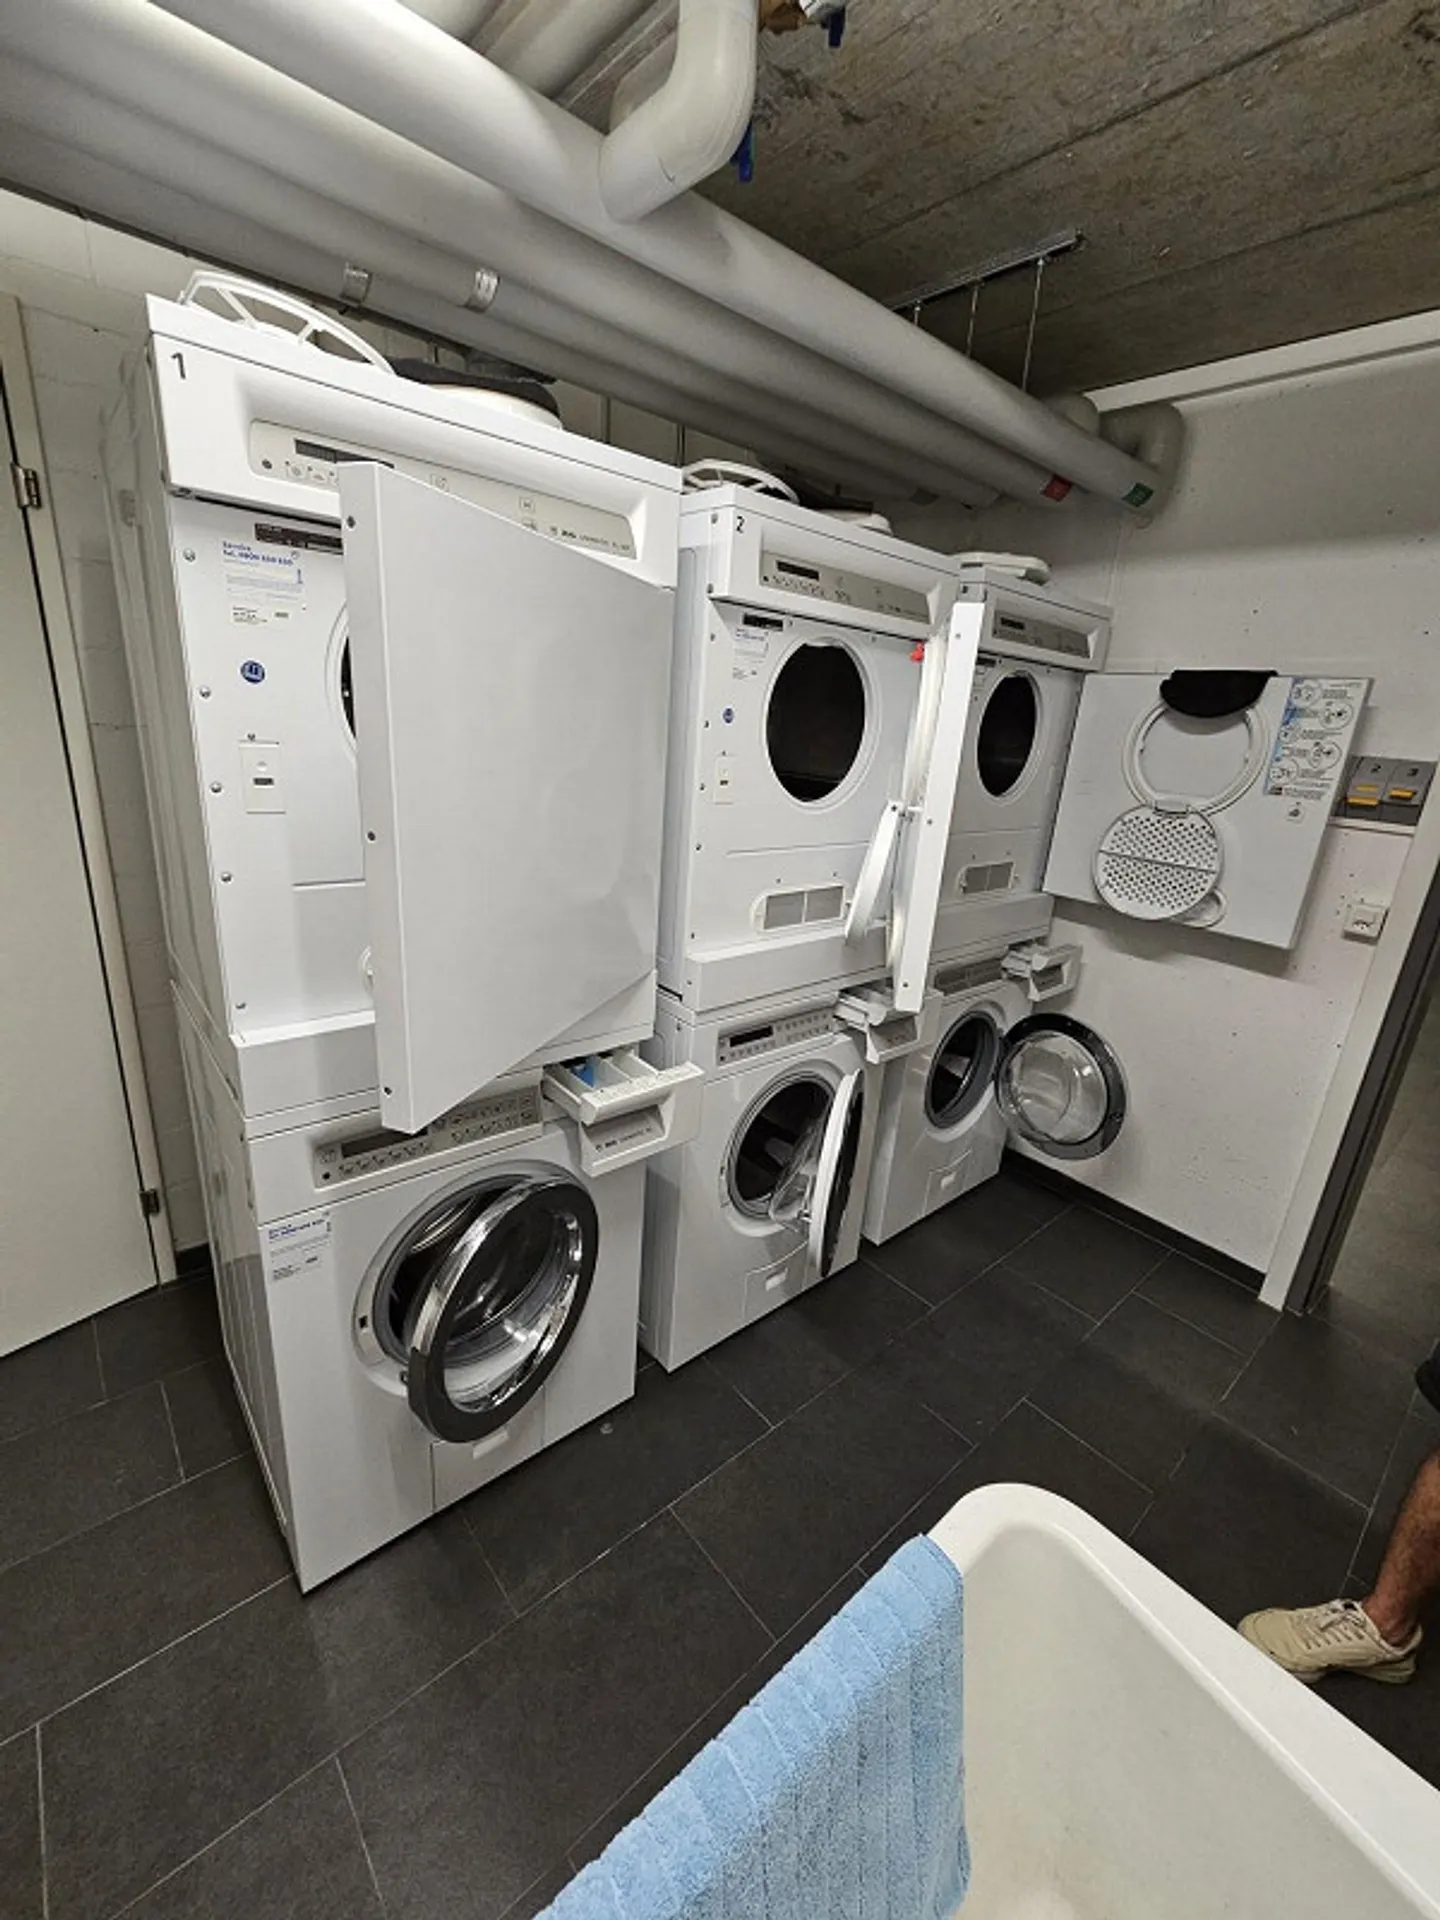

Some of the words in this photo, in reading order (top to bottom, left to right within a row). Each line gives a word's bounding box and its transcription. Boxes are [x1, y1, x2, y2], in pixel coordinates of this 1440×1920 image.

[171, 352, 186, 380] 1
[736, 515, 745, 534] 2
[1370, 762, 1382, 774] 2
